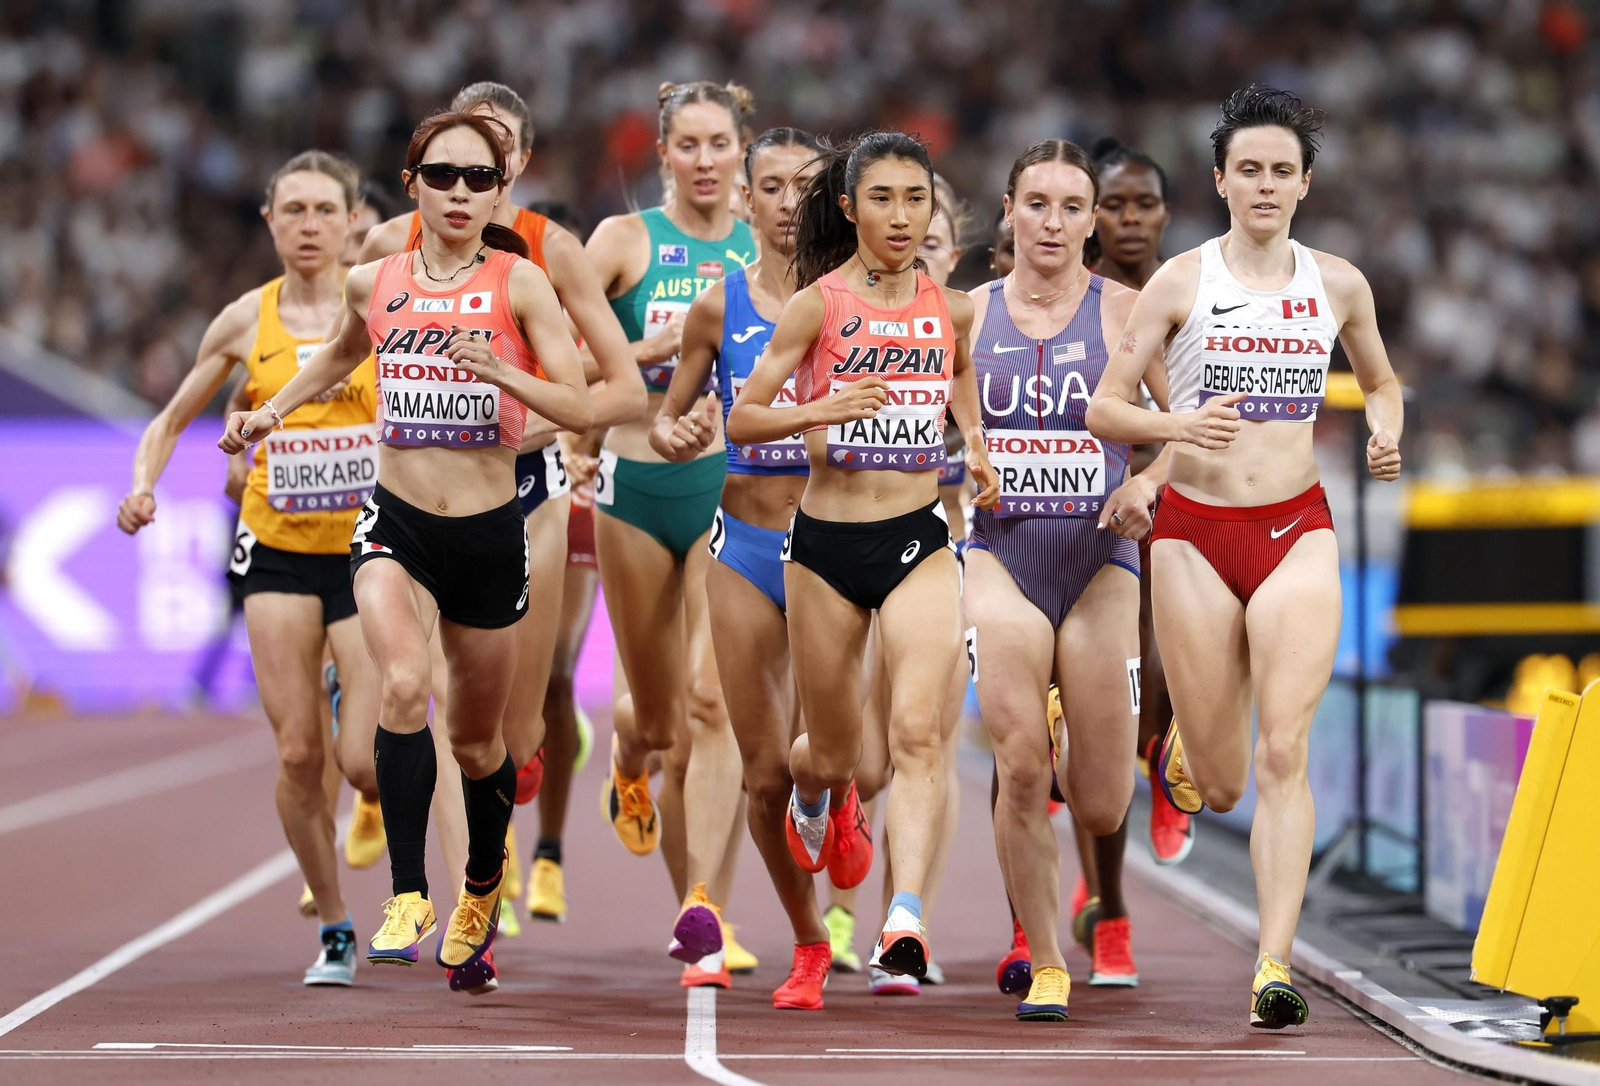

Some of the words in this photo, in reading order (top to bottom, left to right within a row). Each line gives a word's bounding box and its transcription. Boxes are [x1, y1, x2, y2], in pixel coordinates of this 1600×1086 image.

[415, 299, 452, 312] ACN
[872, 322, 906, 335] ACN
[1204, 336, 1328, 355] HONDA
[382, 362, 482, 384] HOND
[832, 346, 945, 375] JAPAN
[1204, 363, 1324, 395] DEBUES-STAFFORD
[384, 390, 495, 421] YAMAMOTO
[983, 371, 1091, 418] USA
[270, 433, 374, 456] HONDA
[986, 438, 1101, 454] HONDA
[274, 457, 376, 490] BURKARD
[992, 466, 1099, 494] RANNY
